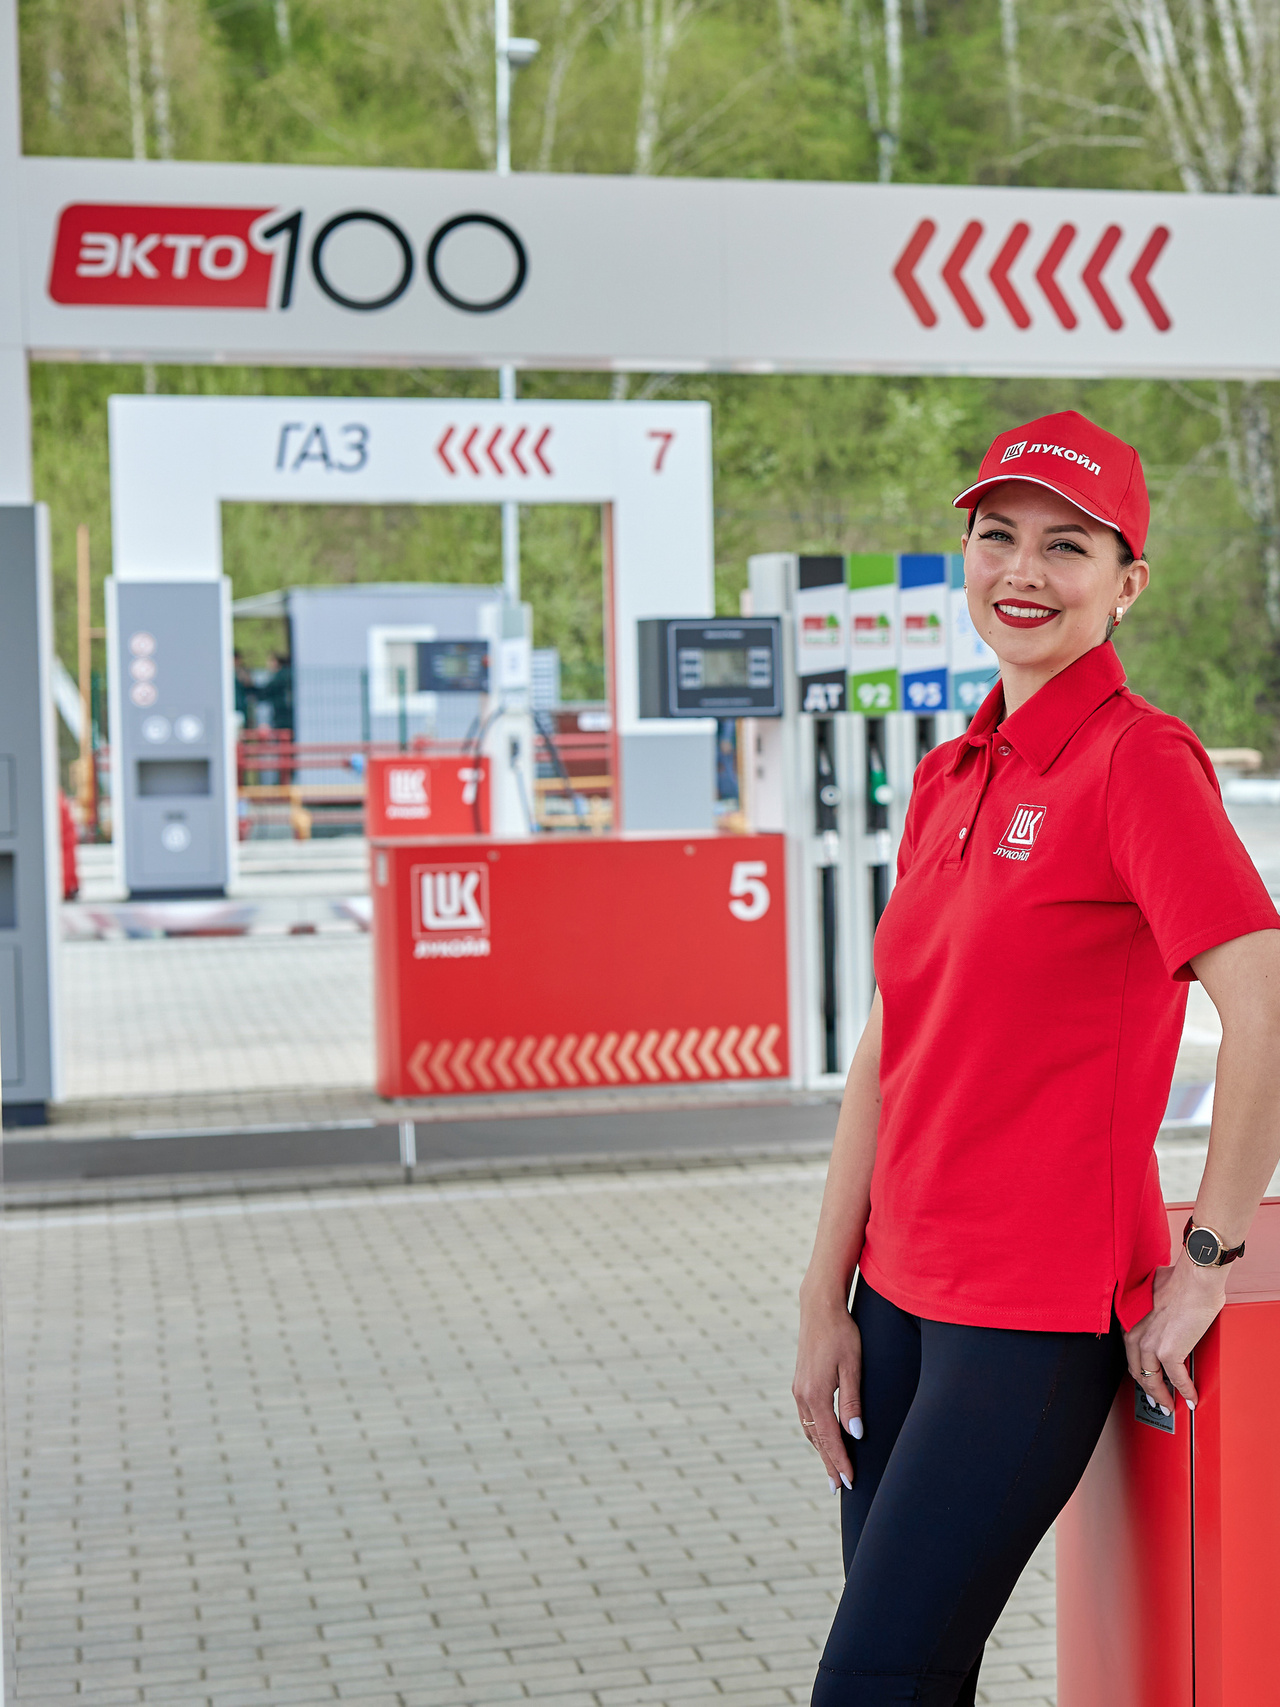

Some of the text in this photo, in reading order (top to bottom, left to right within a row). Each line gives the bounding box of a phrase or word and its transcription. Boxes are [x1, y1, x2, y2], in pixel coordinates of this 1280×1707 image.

[76, 209, 528, 312] ЭКТО 100
[275, 423, 370, 473] ГАЗ
[646, 431, 675, 473] 7
[1027, 444, 1101, 476] ЛУКОЙЛ
[804, 683, 843, 712] ДТ
[857, 683, 891, 708] 92
[457, 768, 485, 805] 7
[993, 847, 1030, 861] ЛУКОЙЛ
[421, 871, 484, 930] LUK
[729, 861, 769, 920] 5
